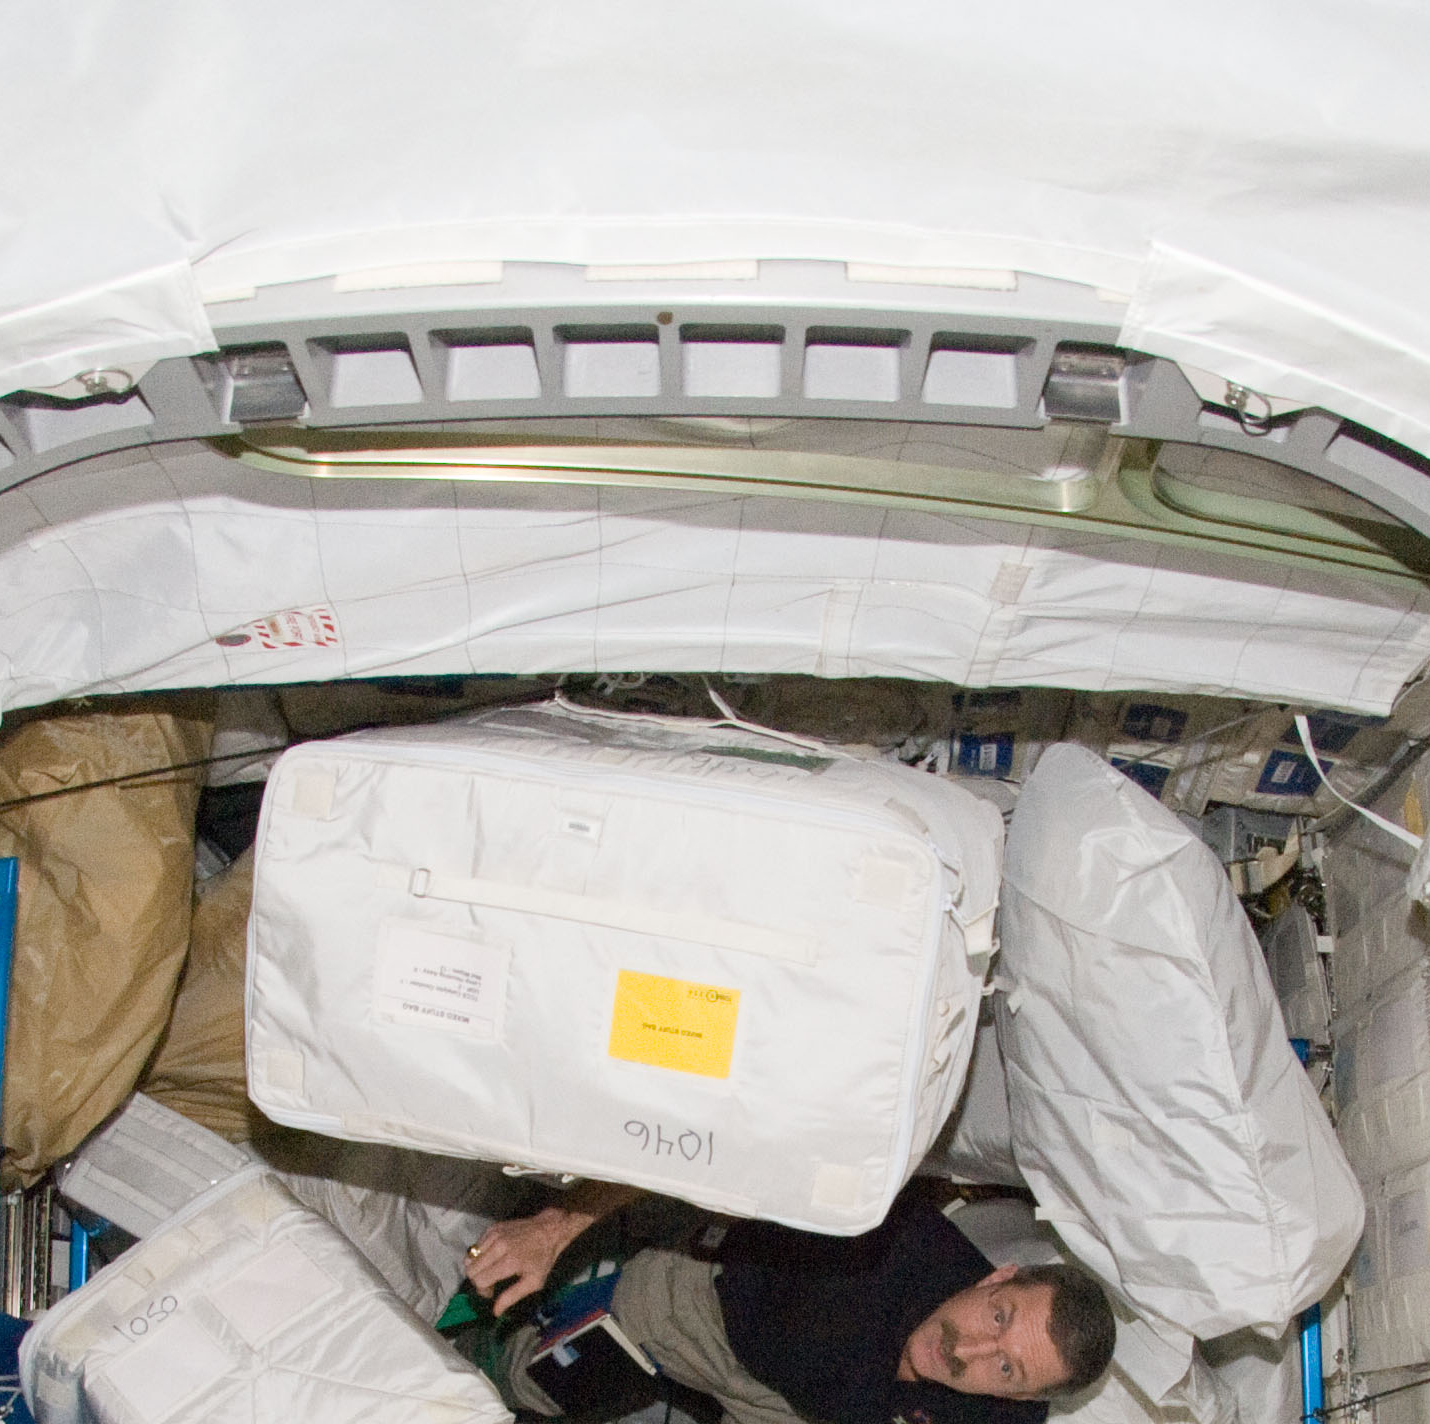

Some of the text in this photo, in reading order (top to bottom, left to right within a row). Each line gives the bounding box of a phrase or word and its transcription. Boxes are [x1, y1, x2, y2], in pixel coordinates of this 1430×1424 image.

[421, 1007, 445, 1017] STUFF
[446, 1012, 470, 1024] MIXED
[623, 1119, 714, 1166] 1046
[113, 1295, 178, 1343] 1050
